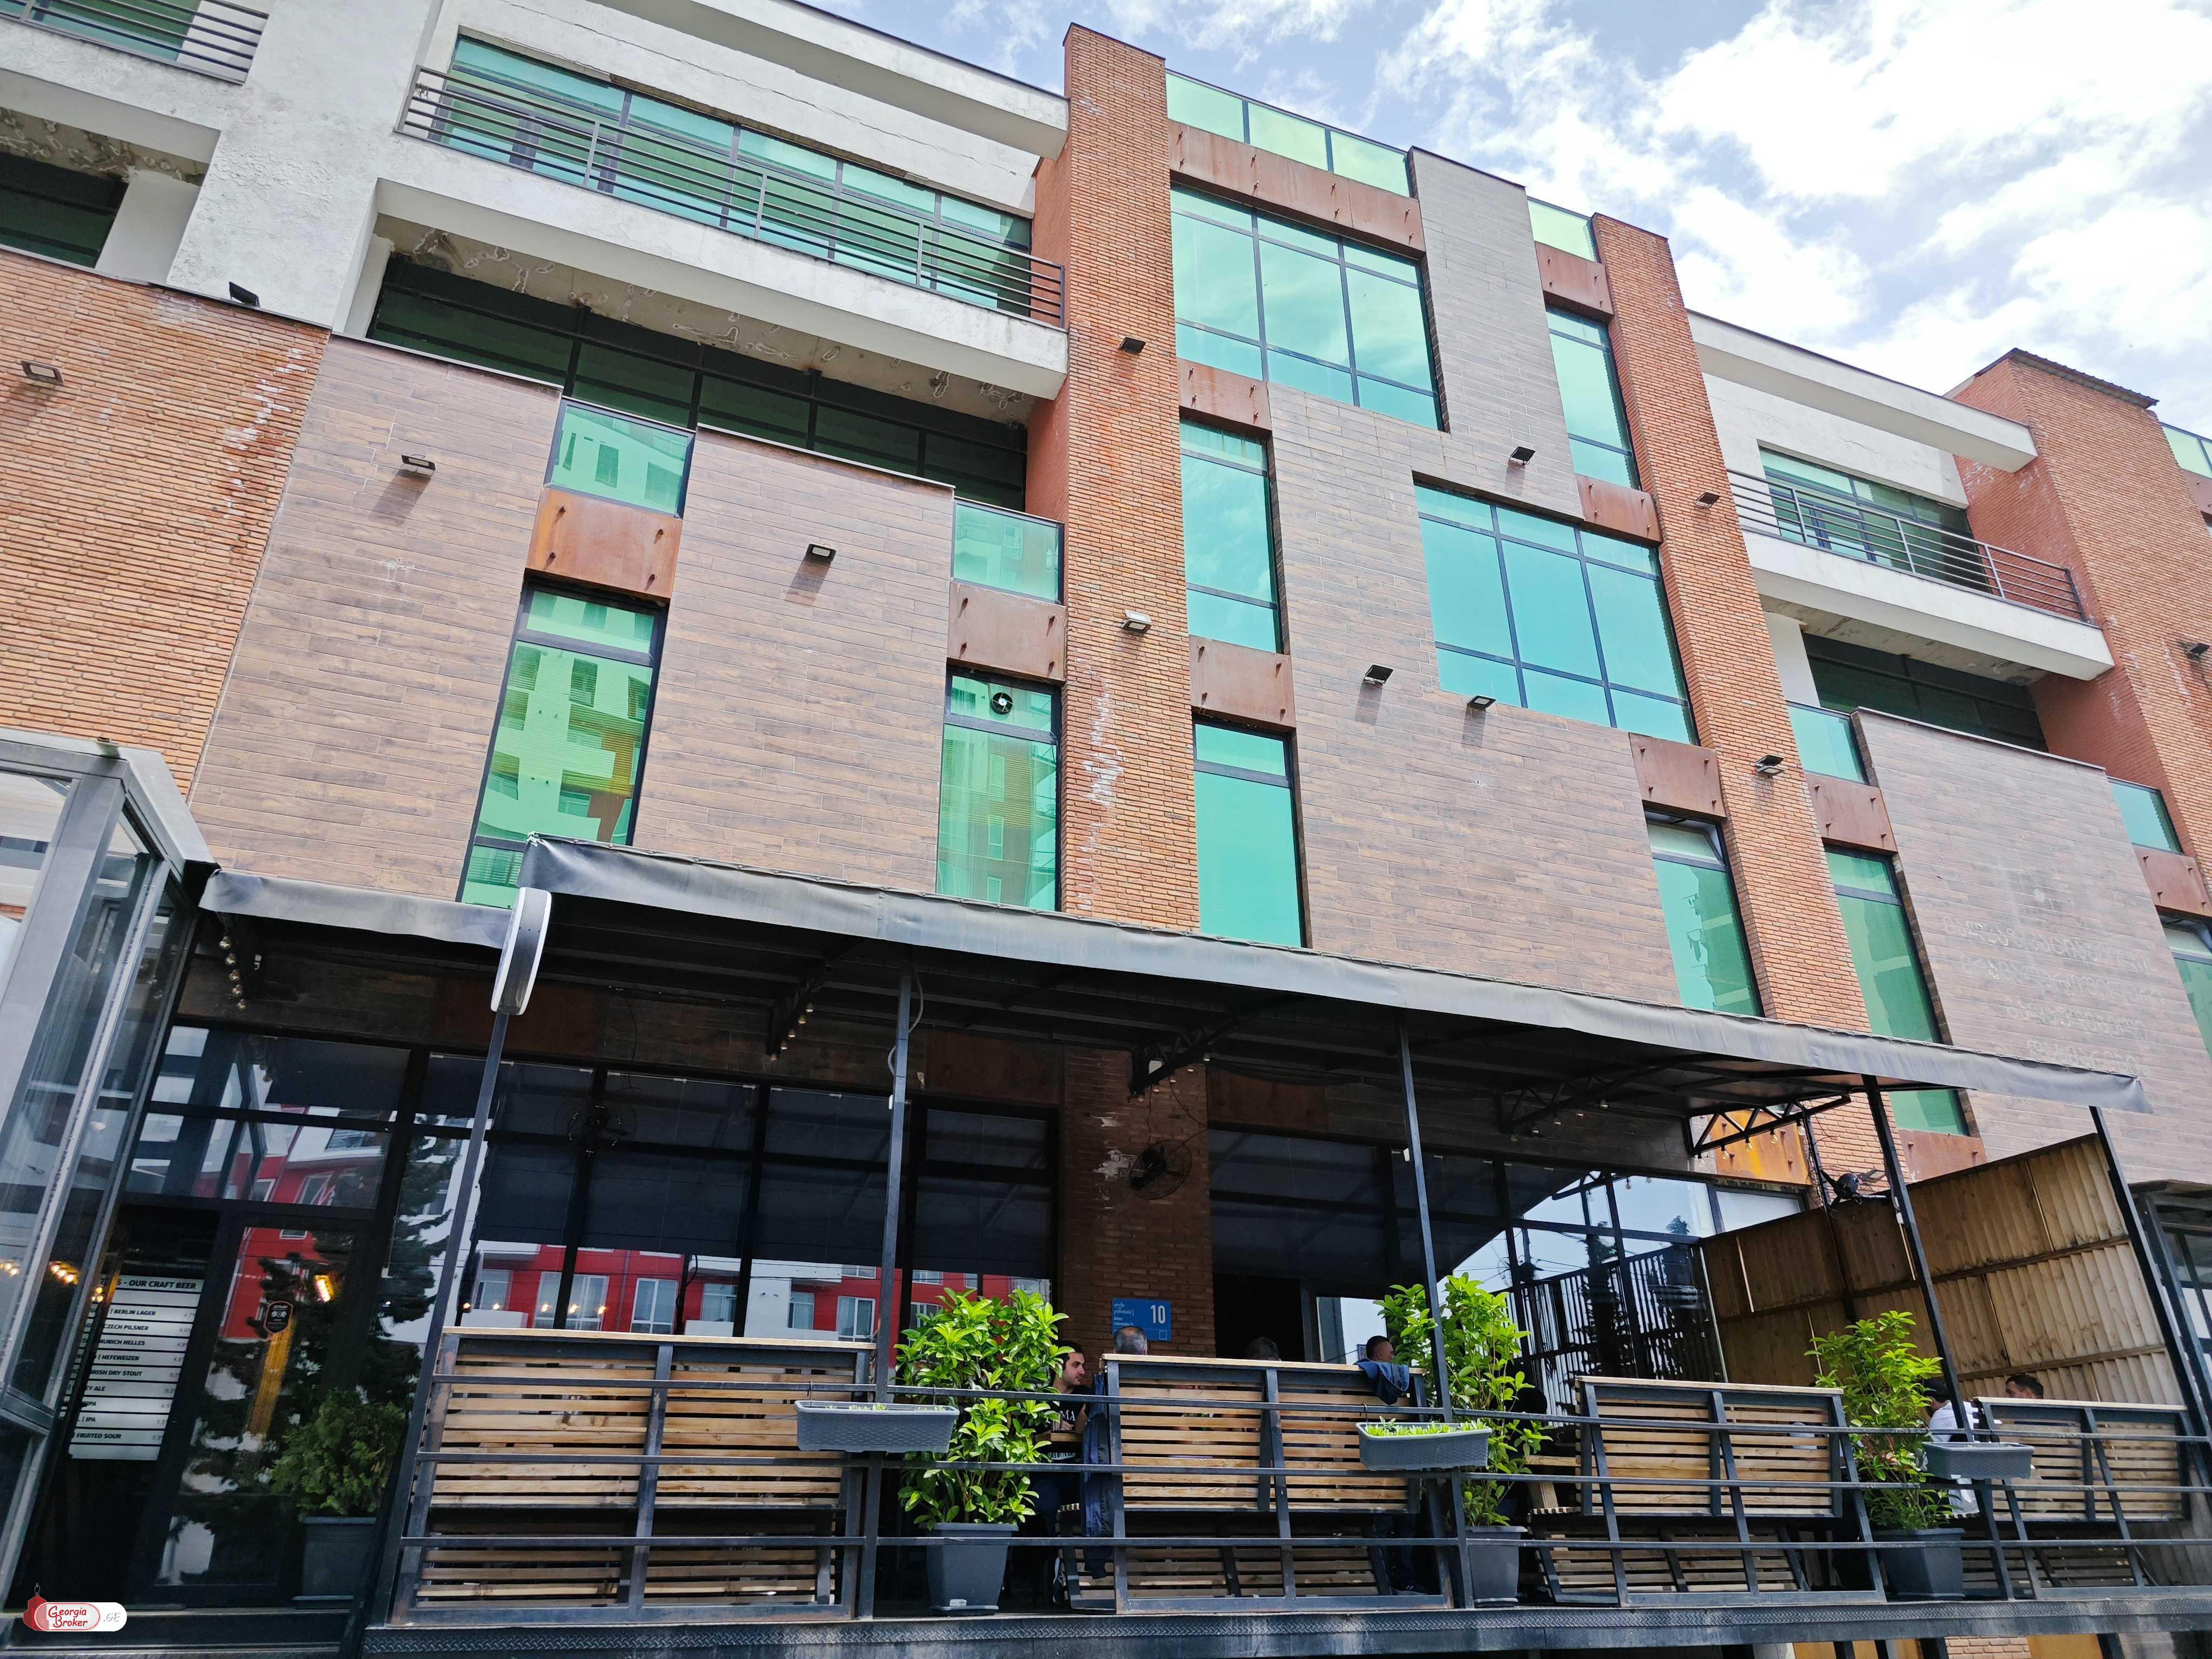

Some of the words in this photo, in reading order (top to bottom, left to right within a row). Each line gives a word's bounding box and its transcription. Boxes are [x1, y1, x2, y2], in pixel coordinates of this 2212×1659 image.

[129, 1279, 147, 1287] OUR
[149, 1280, 175, 1289] CRAFT
[1150, 1305, 1165, 1324] 10
